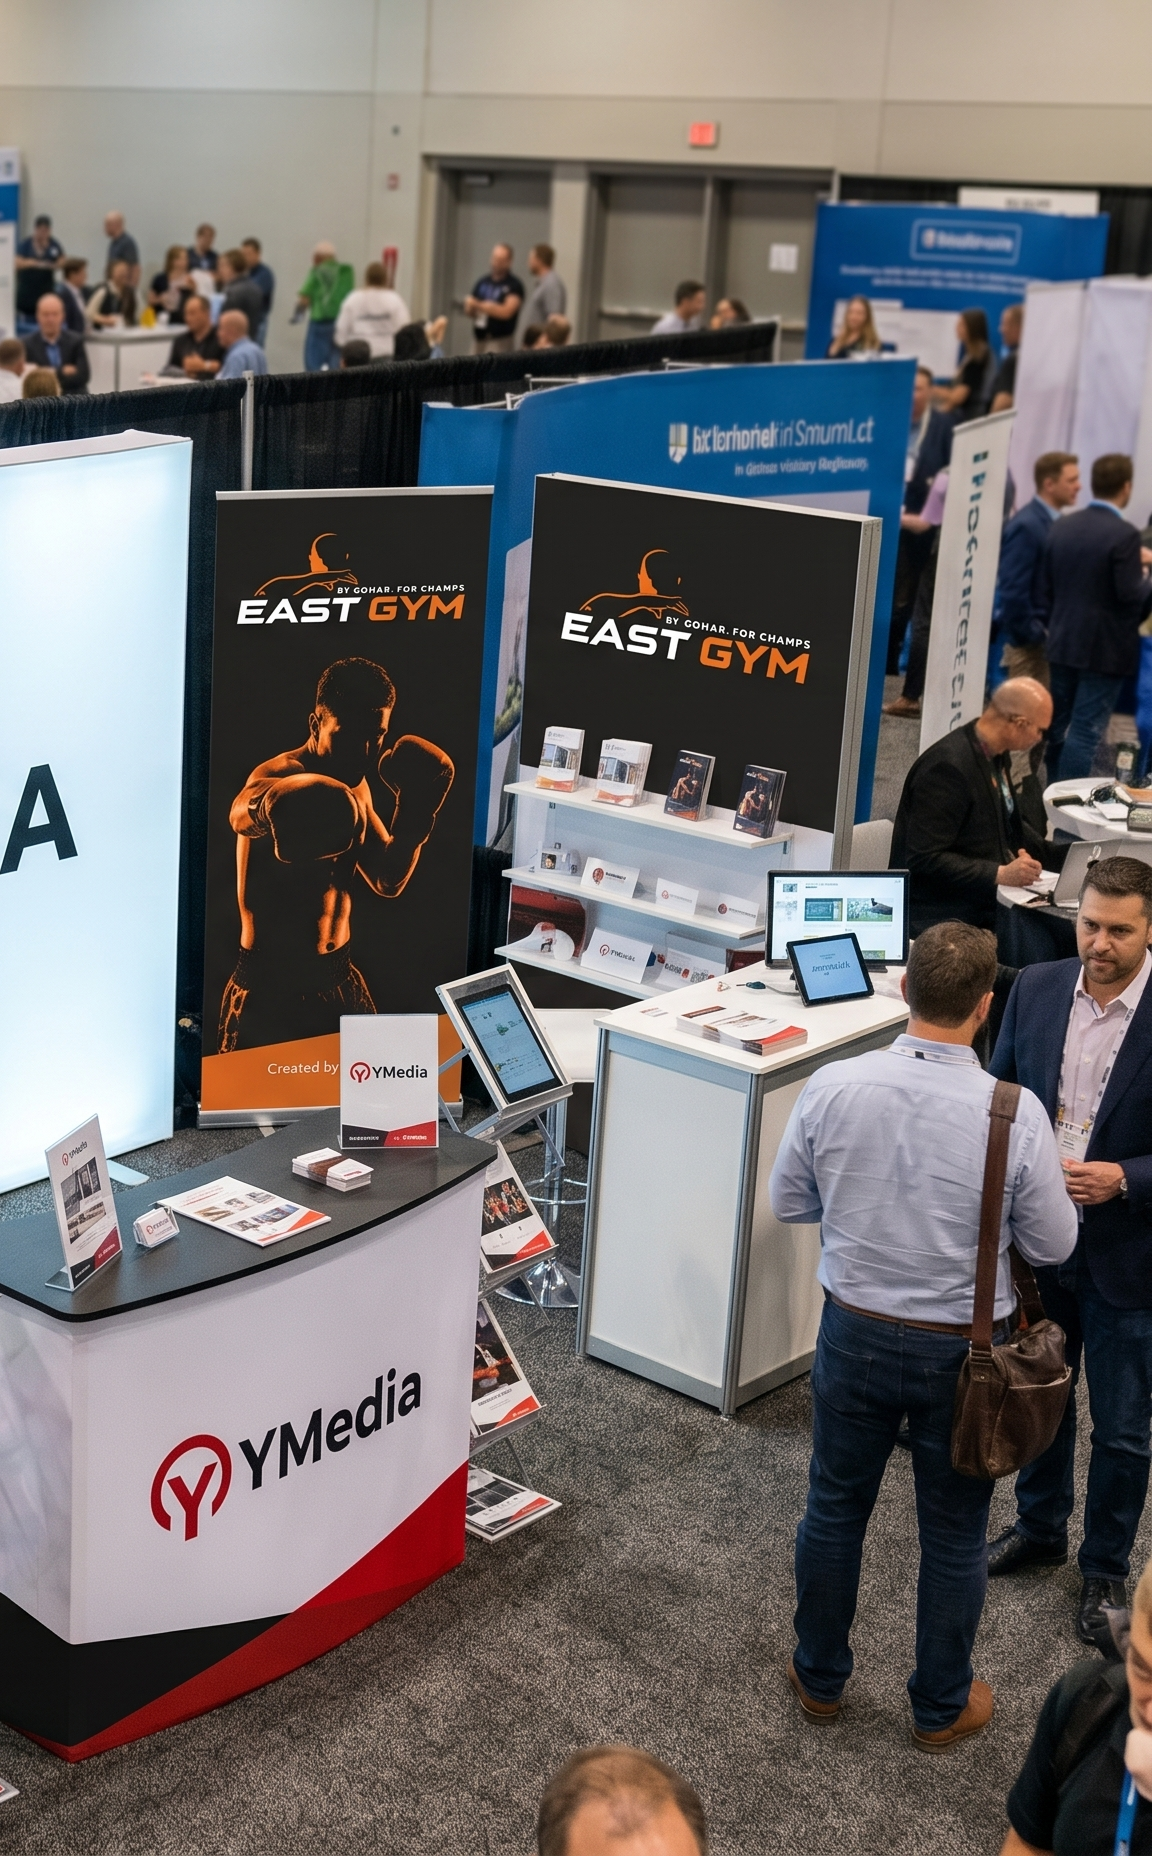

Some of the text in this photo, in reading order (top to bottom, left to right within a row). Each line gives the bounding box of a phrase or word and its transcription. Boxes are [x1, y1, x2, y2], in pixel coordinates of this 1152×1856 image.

[353, 586, 394, 594] GOHAR.
[397, 585, 417, 593] FOR
[421, 584, 465, 592] CHAMPS
[237, 594, 465, 624] EAST GYM
[560, 611, 810, 684] EAST GYM
[665, 616, 811, 649] BY GOHAR. FOR CHAMPS
[267, 1060, 340, 1076] Created by
[372, 1065, 428, 1078] YMedia
[238, 1367, 421, 1491] YMedia
